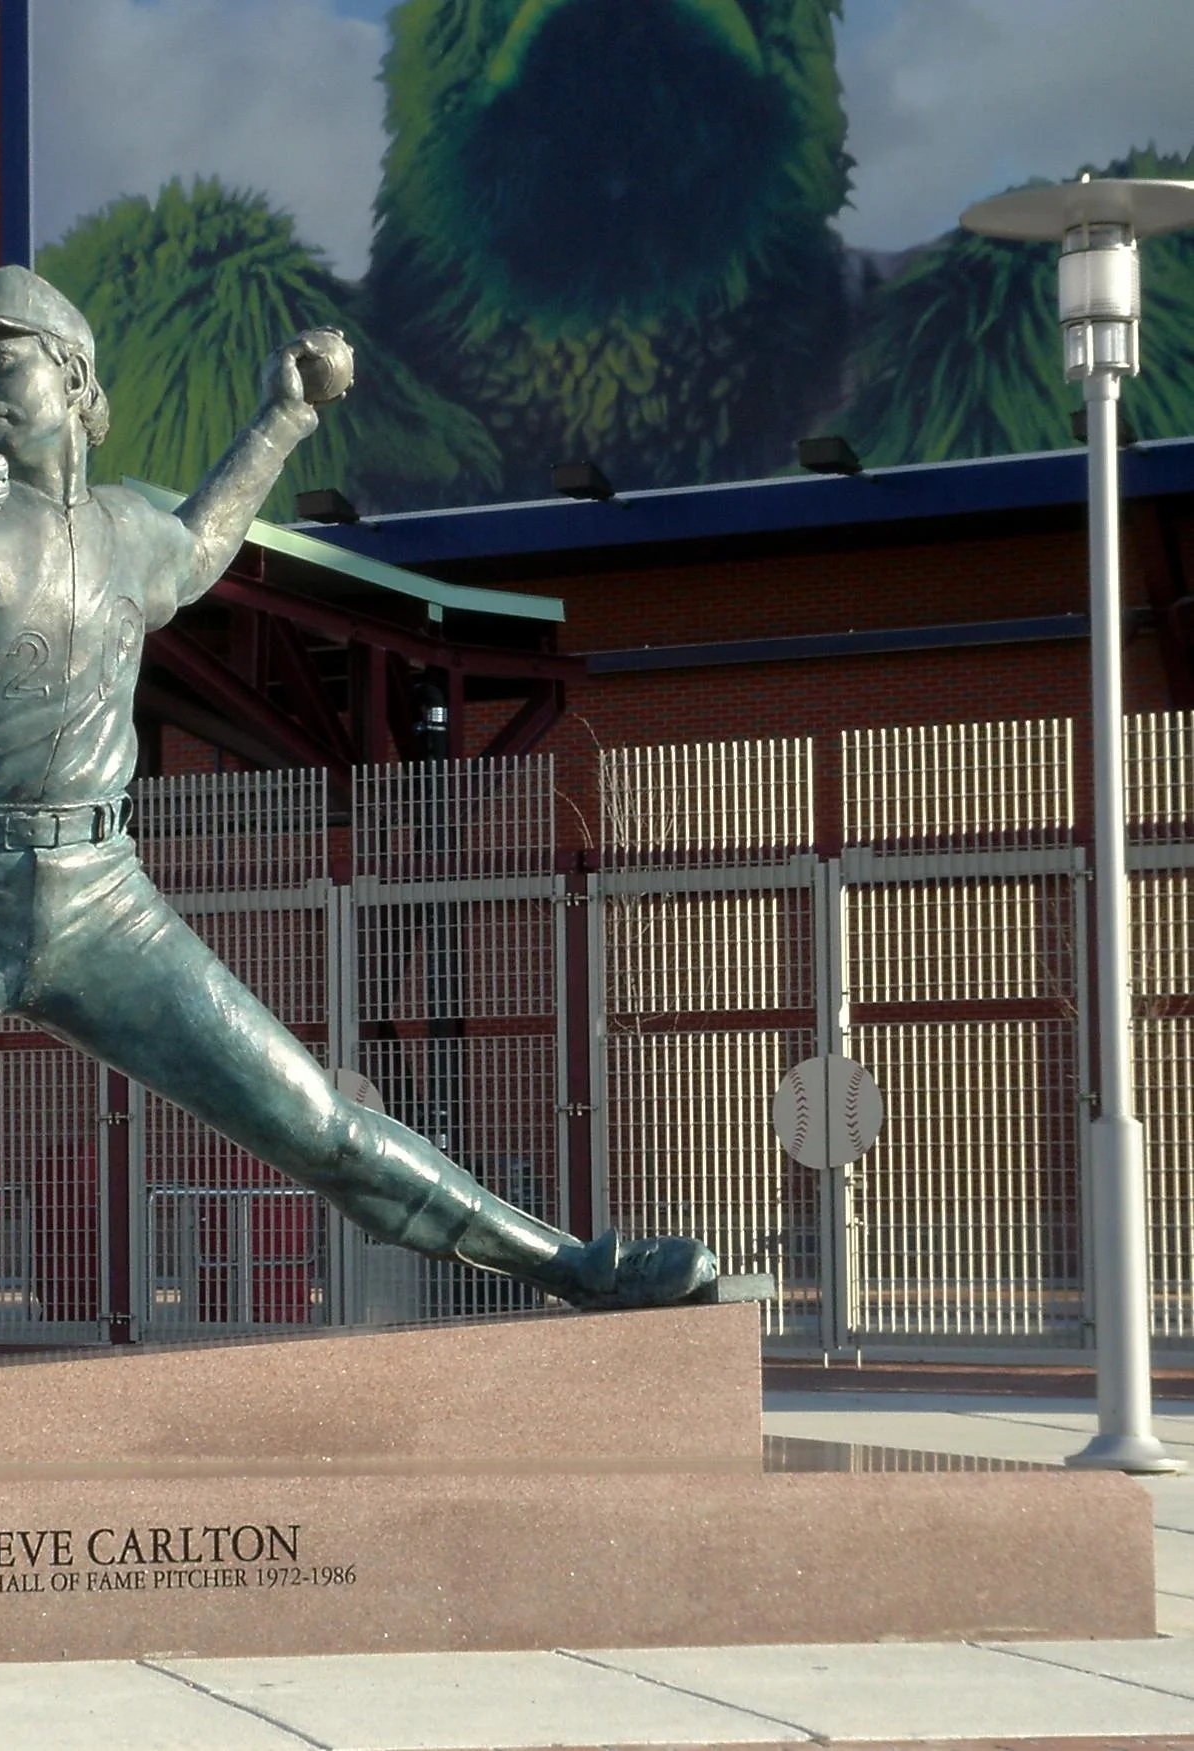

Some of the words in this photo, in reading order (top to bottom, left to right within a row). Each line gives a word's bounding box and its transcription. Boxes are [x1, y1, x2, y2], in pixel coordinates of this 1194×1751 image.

[86, 1524, 301, 1566] CARLTON
[50, 1571, 81, 1592] OF
[86, 1570, 147, 1591] FAME
[153, 1567, 249, 1590] PITCHER
[257, 1564, 357, 1589] 1972-1986
